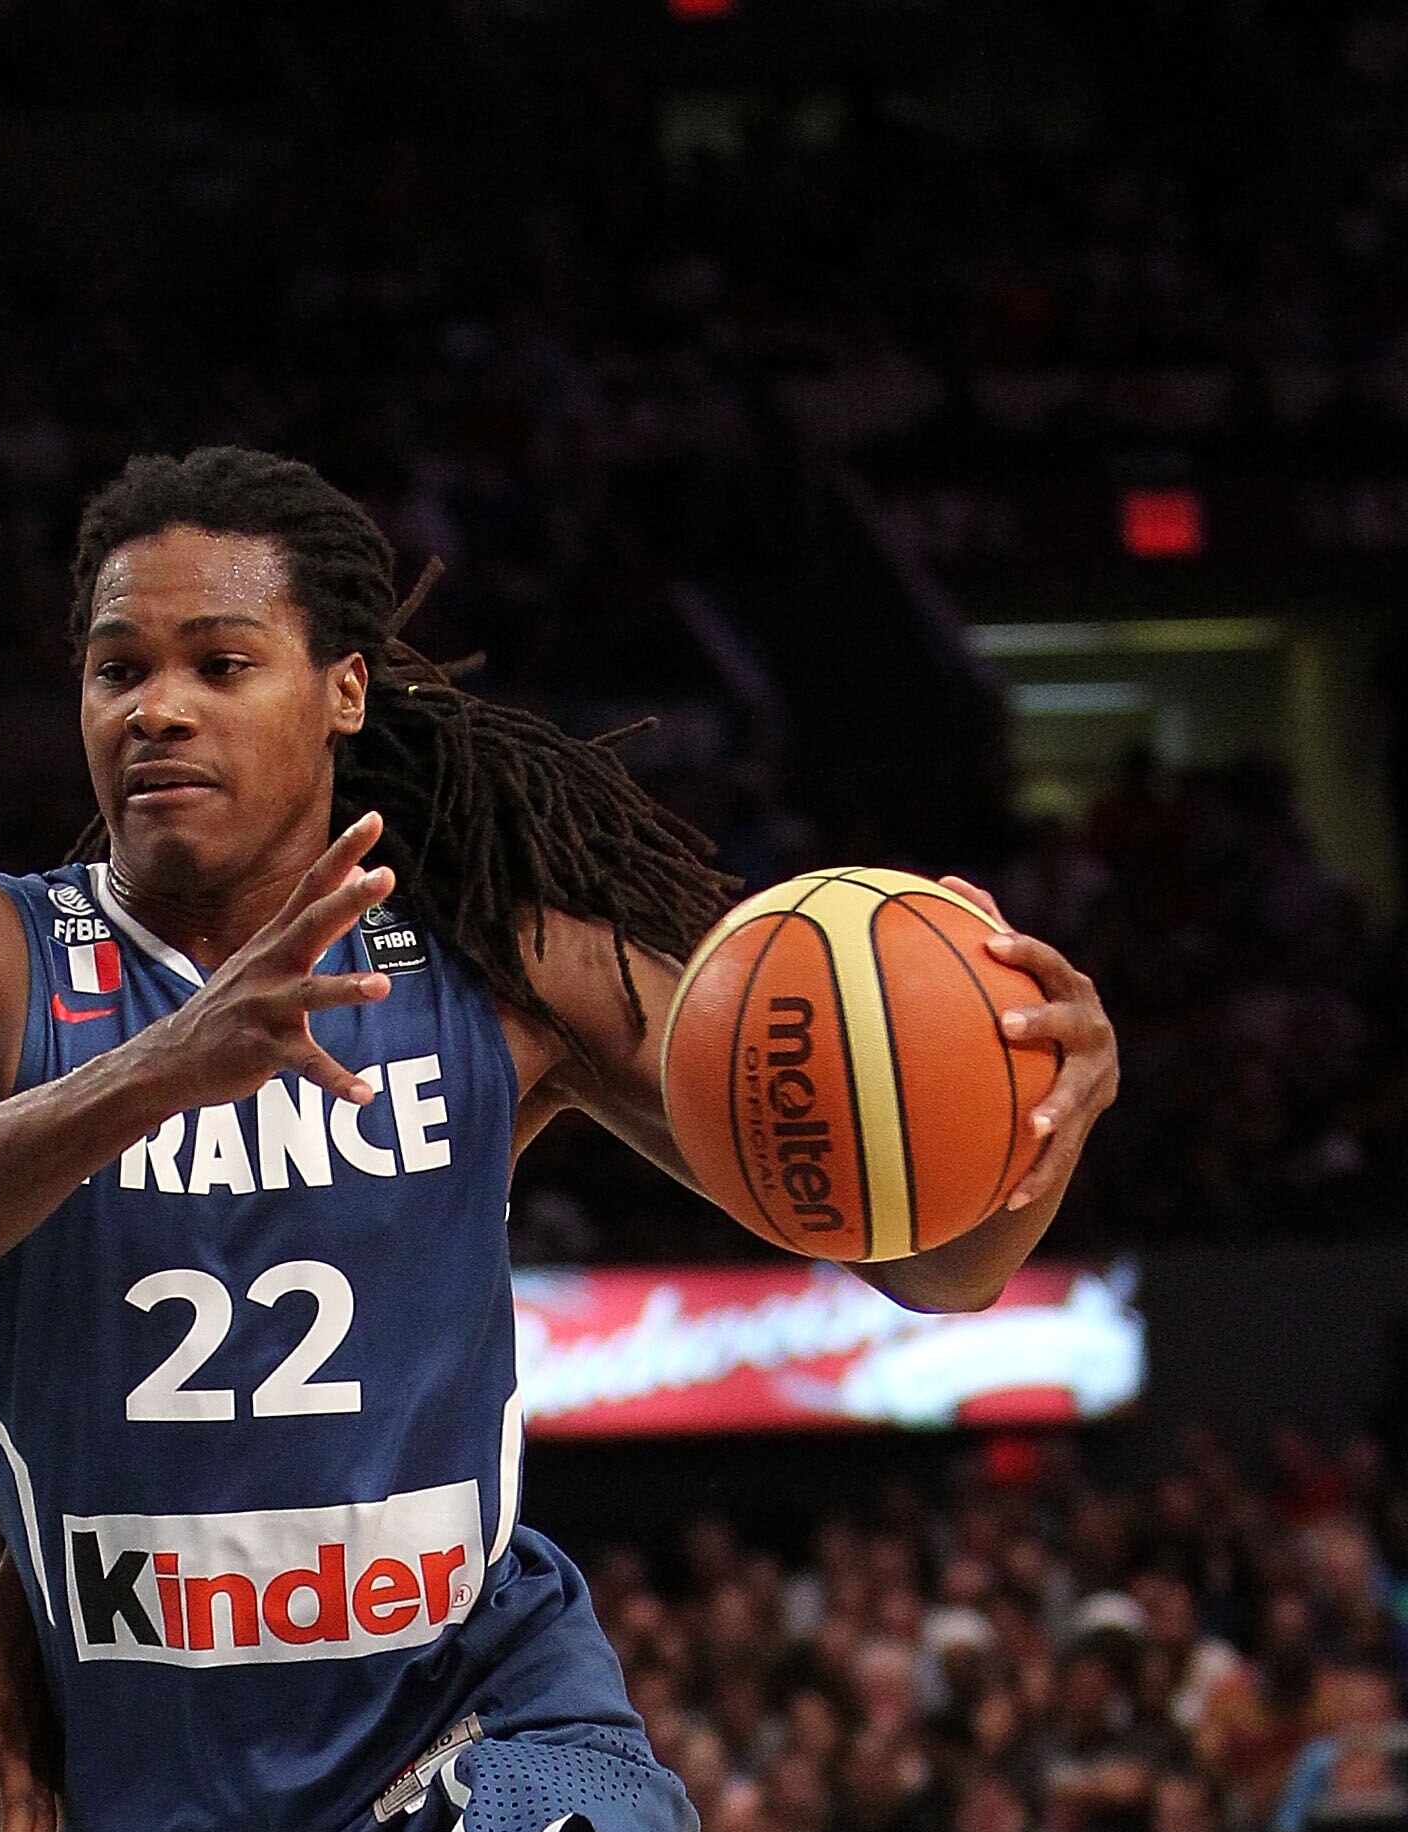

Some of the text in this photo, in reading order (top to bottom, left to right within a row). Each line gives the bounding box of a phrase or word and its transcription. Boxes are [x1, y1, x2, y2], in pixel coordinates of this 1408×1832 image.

[54, 918, 111, 943] FFBB
[373, 930, 417, 950] FIBA
[72, 1053, 452, 1195] RANCE
[767, 996, 844, 1233] molten
[125, 1260, 362, 1422] 22
